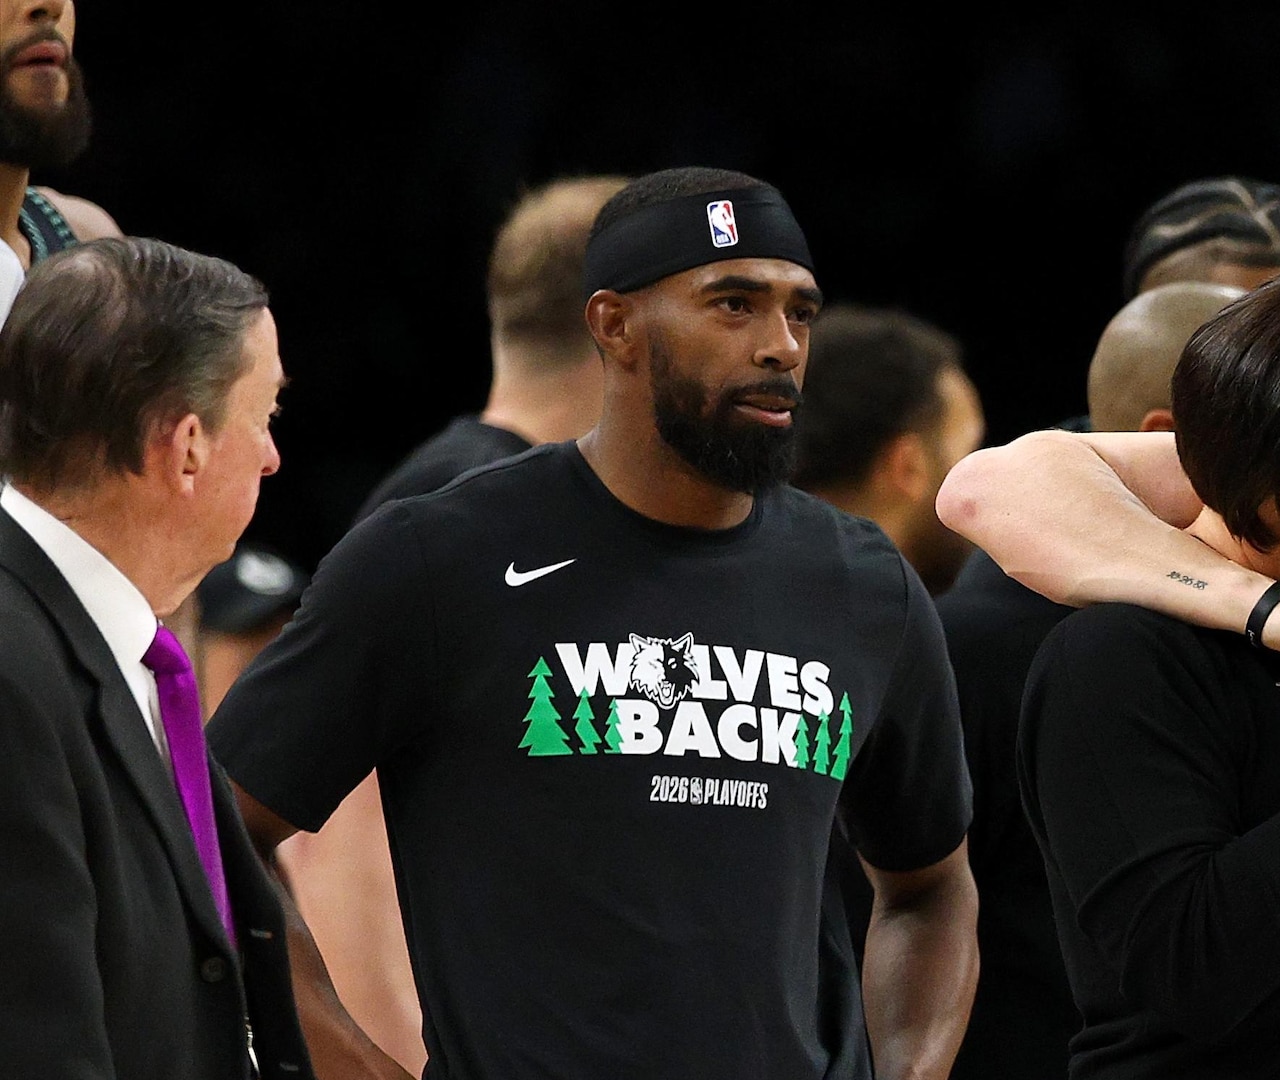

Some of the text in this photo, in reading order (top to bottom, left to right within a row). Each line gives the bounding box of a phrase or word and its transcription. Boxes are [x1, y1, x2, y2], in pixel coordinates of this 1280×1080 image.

[616, 698, 804, 769] BACK
[650, 774, 770, 810] 2026 PLAYOFFS
